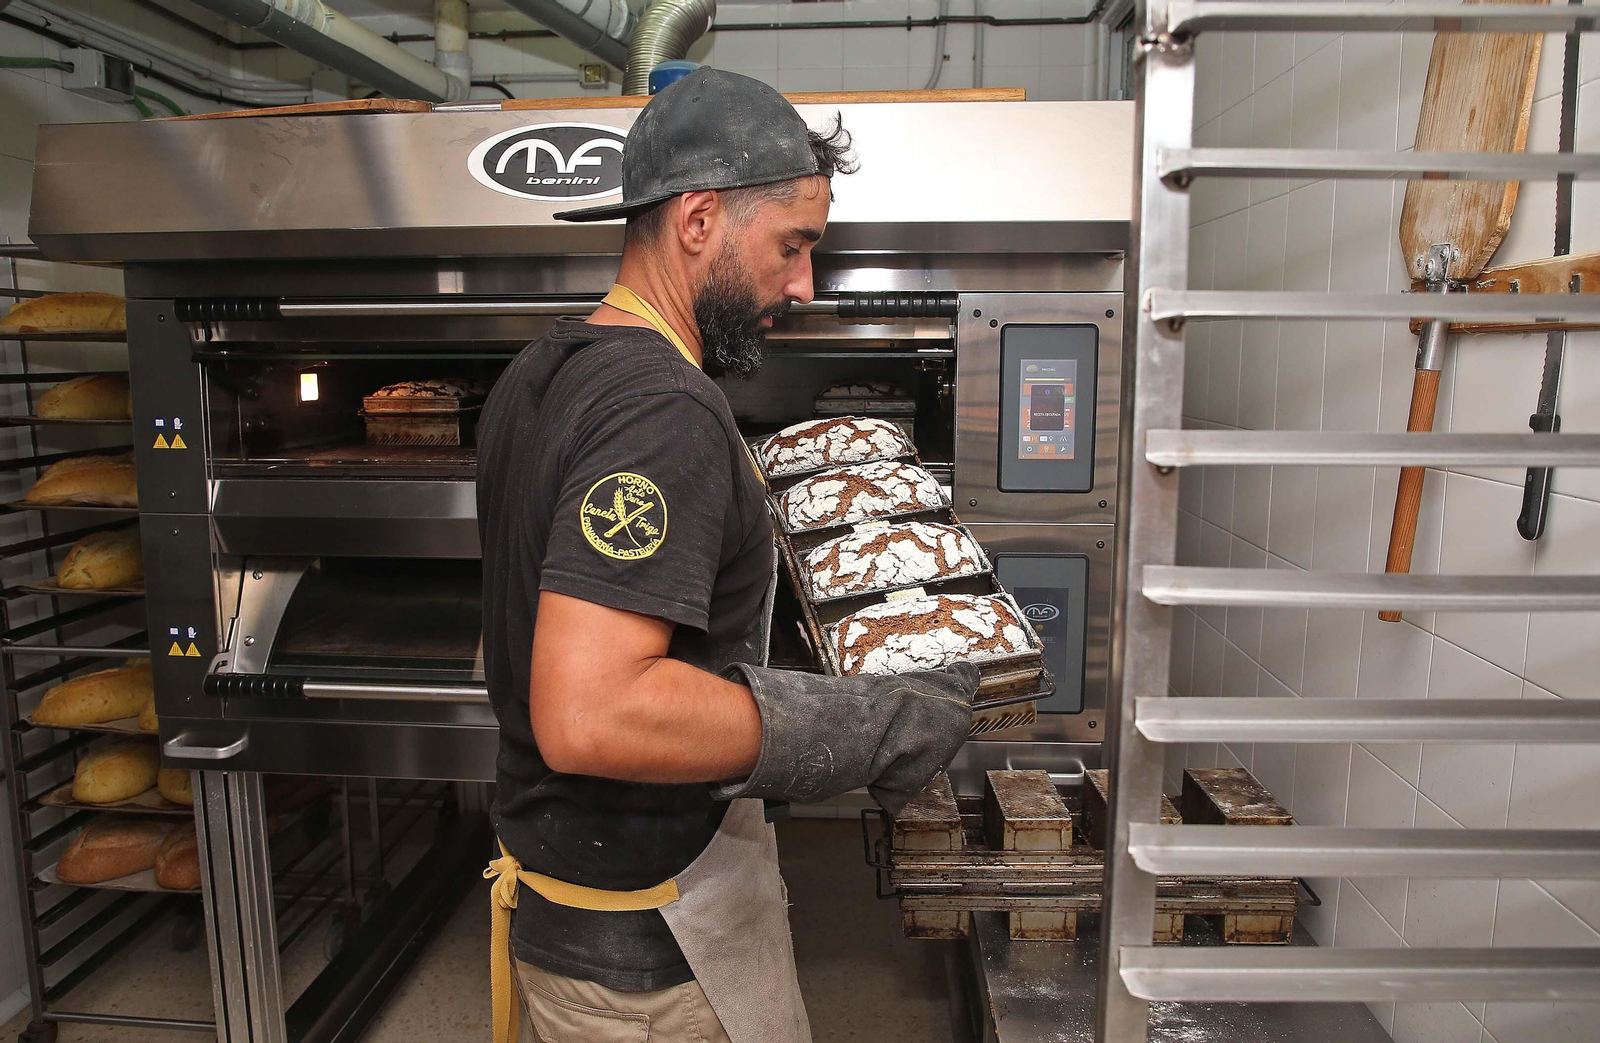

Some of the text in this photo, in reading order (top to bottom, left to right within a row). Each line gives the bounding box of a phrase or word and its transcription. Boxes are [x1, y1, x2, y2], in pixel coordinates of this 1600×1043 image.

[526, 176, 601, 185] benini
[618, 476, 654, 494] HORNO
[584, 503, 617, 521] Canela
[635, 516, 659, 536] Trigo
